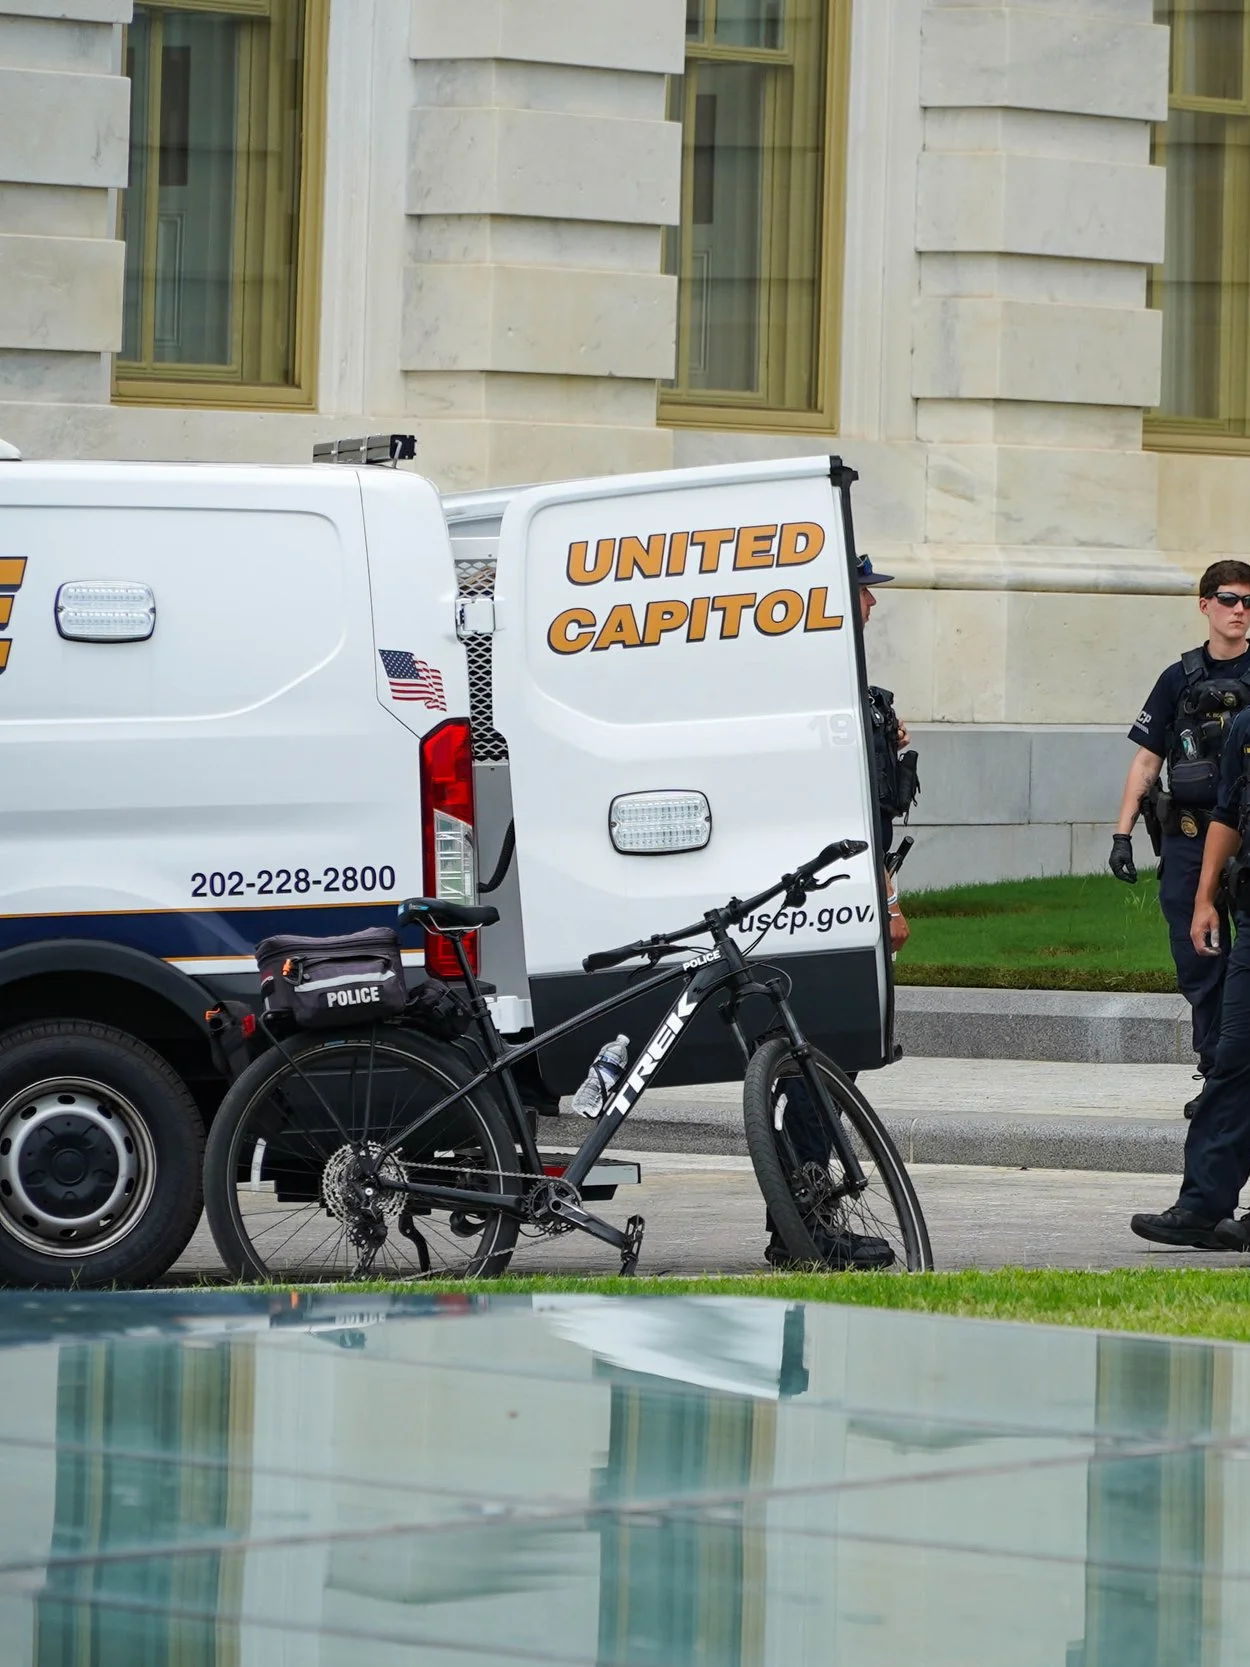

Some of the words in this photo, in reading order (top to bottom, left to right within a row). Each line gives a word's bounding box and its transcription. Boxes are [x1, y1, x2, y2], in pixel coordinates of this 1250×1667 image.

[566, 521, 825, 586] UNITED
[547, 586, 844, 655] CAPITOL
[807, 713, 857, 750] 19
[191, 865, 396, 898] 202-228-2800
[682, 950, 721, 971] POLICE
[326, 986, 380, 1008] POLICE
[606, 991, 699, 1117] TREK
